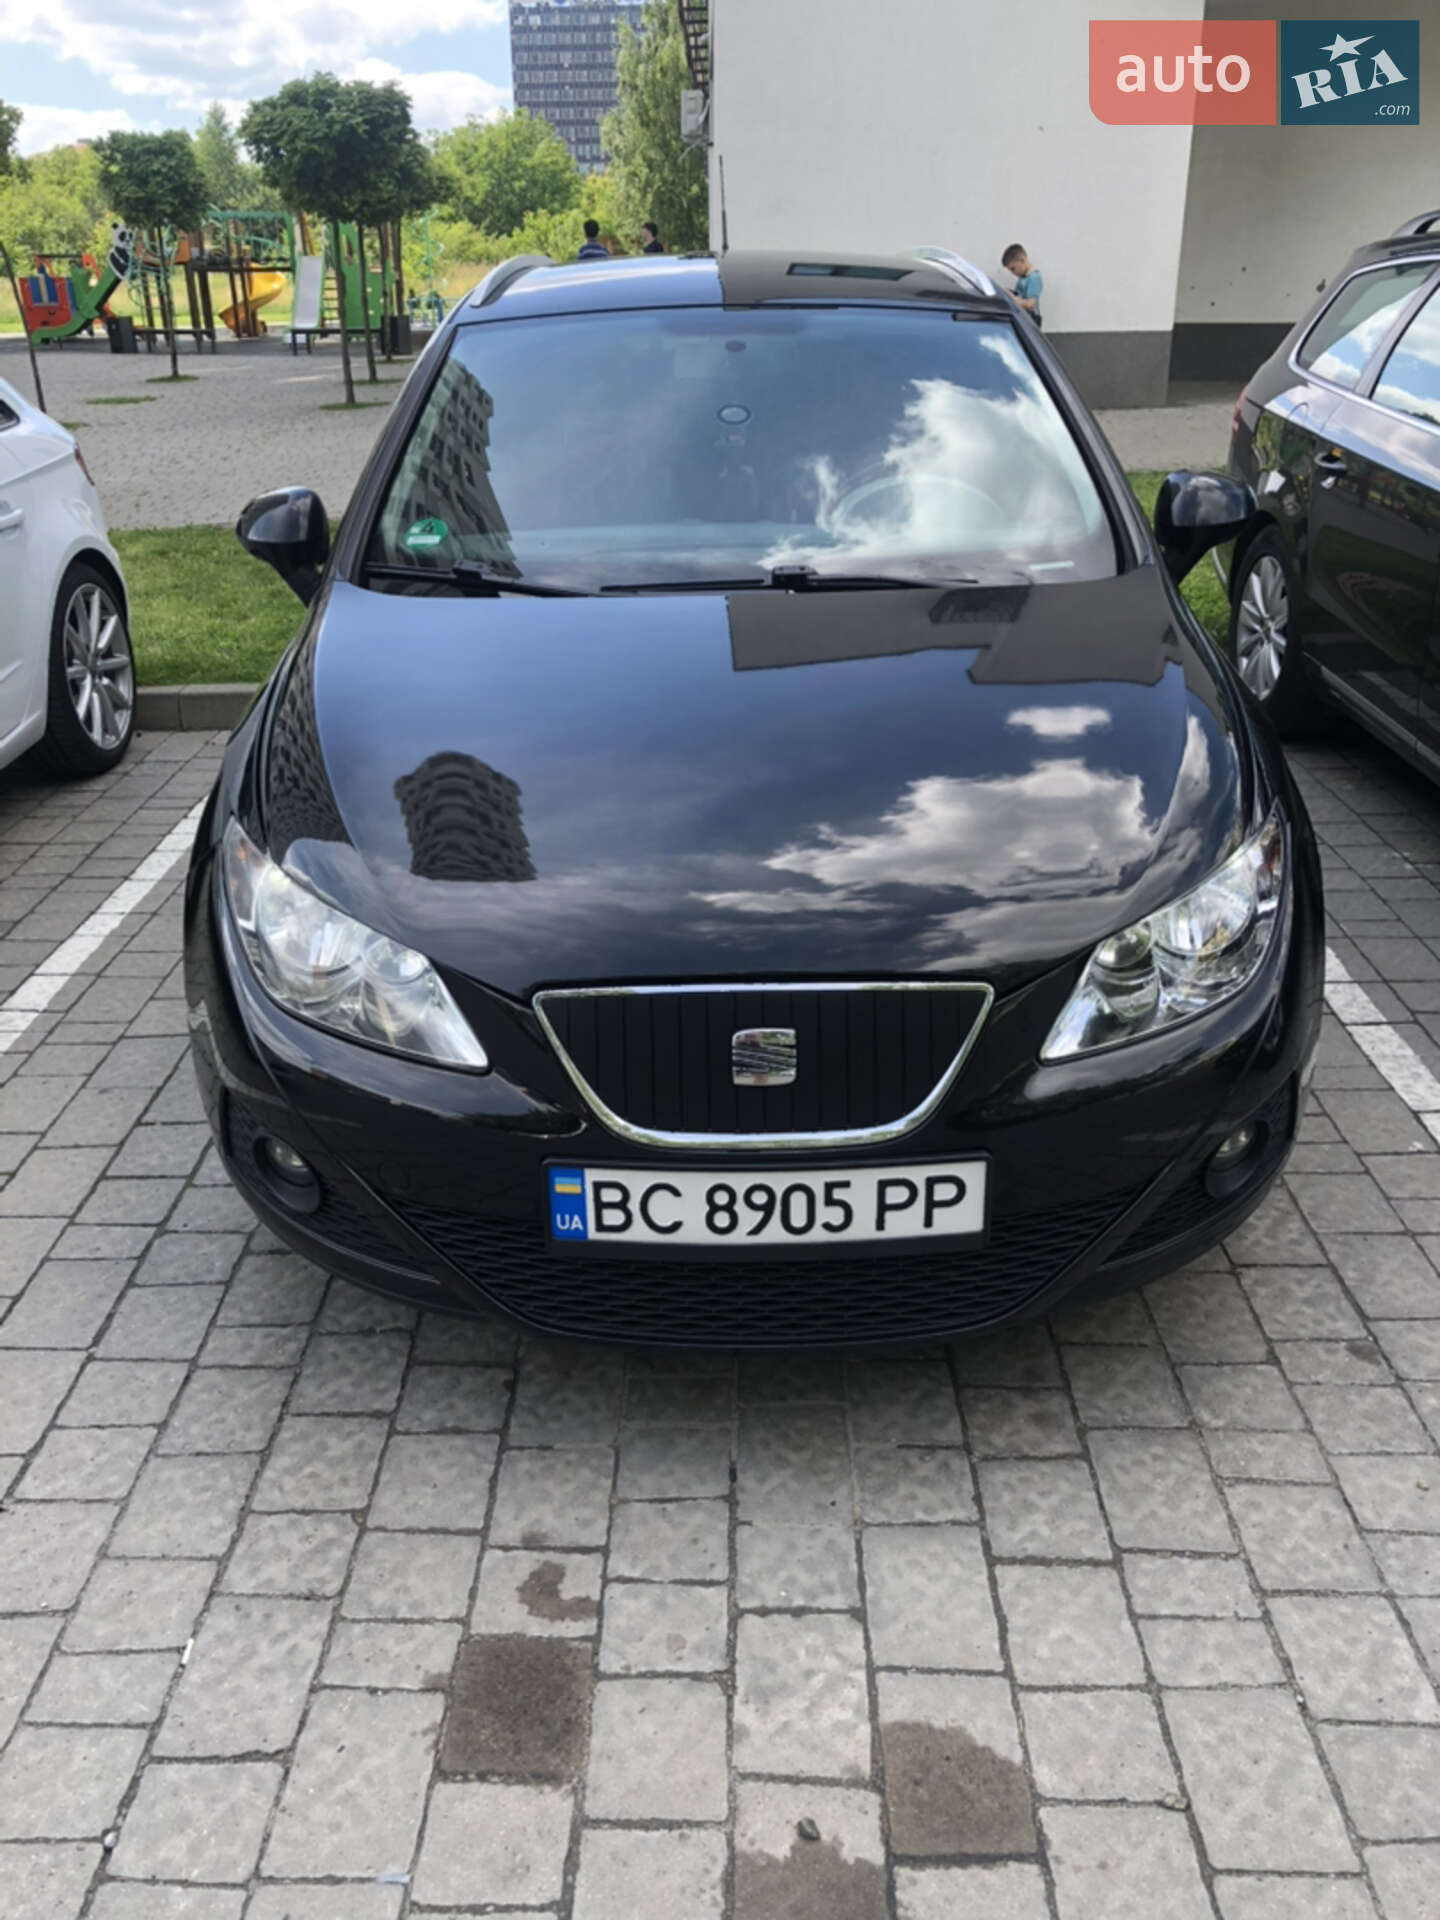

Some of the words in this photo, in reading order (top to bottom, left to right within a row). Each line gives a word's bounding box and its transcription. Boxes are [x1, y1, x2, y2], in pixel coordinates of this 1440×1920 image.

[556, 1213, 584, 1231] UA
[592, 1180, 684, 1234] BC
[705, 1180, 853, 1236] 8905
[875, 1175, 967, 1232] PP
